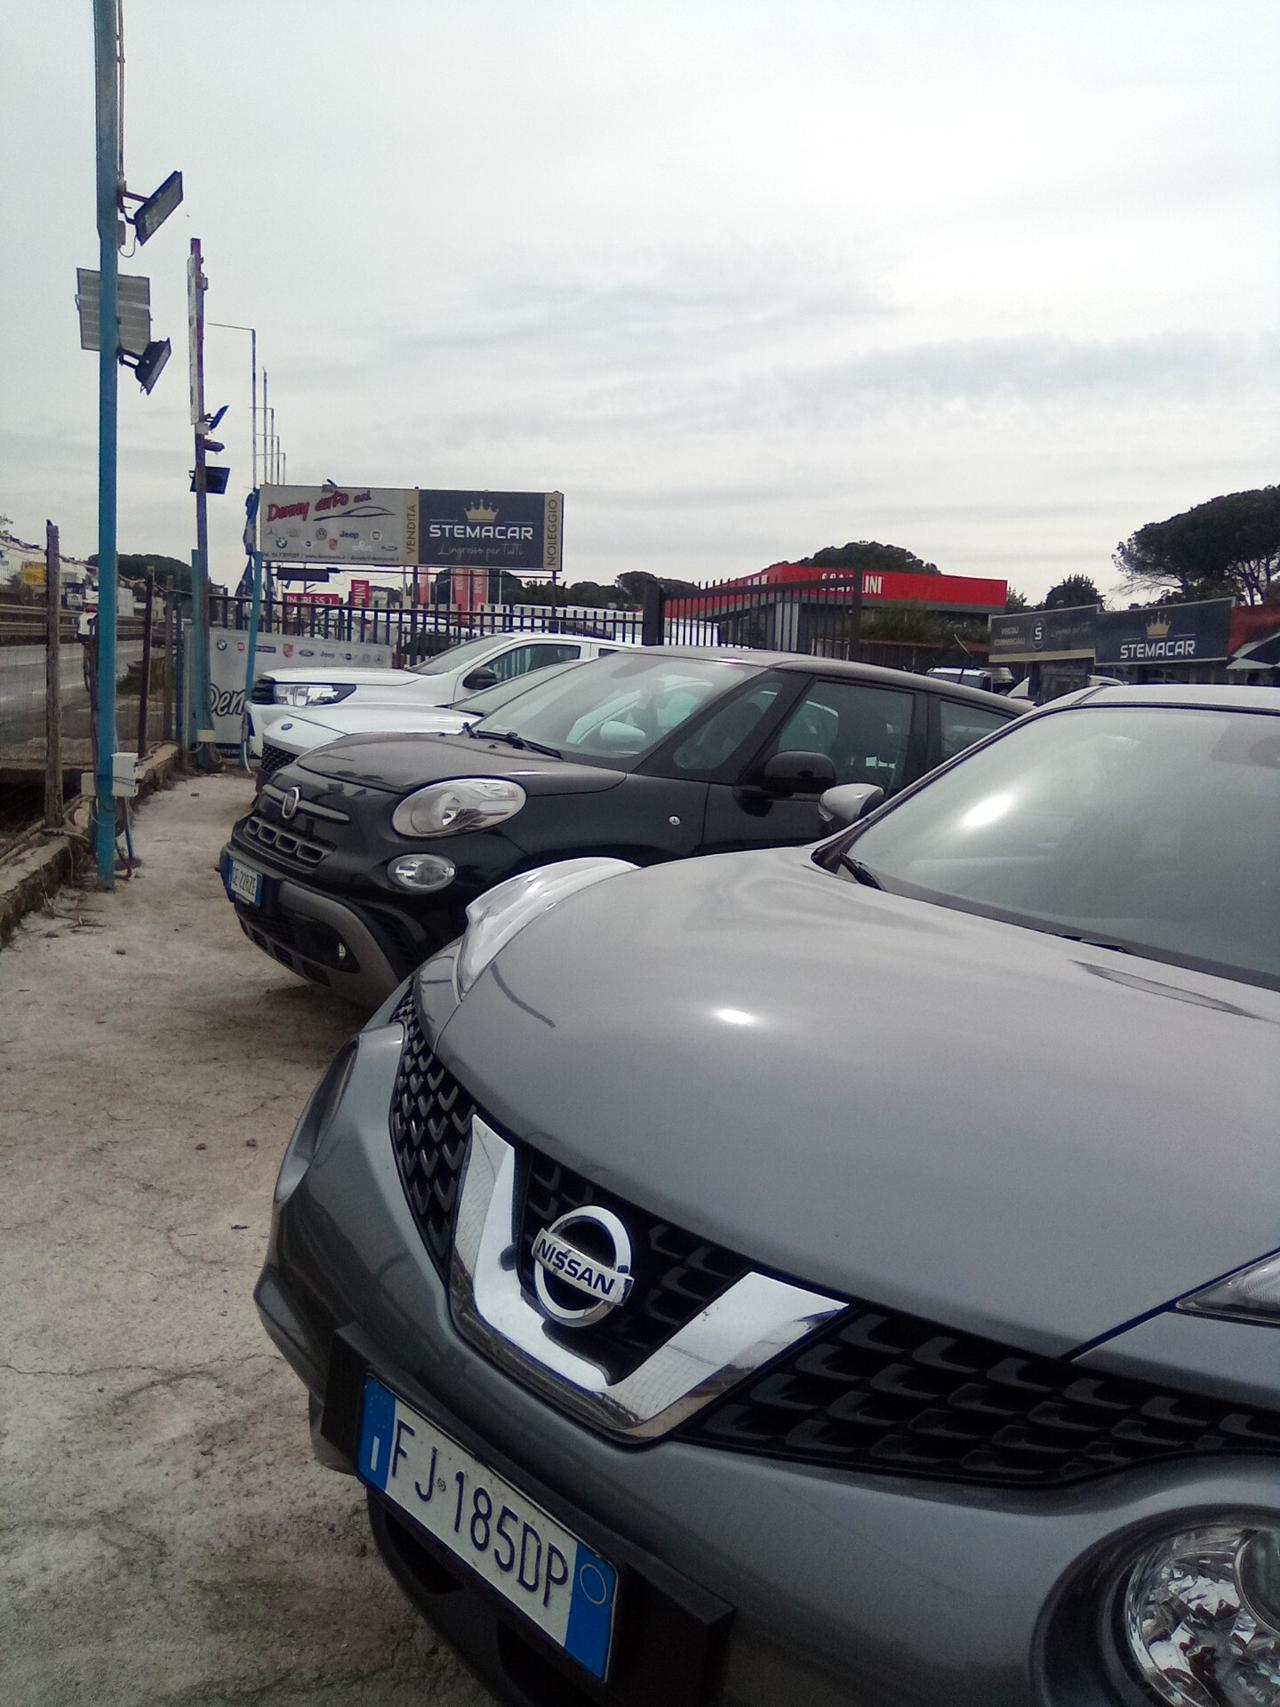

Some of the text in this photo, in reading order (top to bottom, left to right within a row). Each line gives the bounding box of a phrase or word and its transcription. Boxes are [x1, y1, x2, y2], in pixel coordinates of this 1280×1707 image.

[339, 530, 360, 540] Jeep
[405, 504, 417, 555] VENDITA
[429, 524, 533, 541] STEMACAR
[547, 498, 558, 566] NOLEGGIO
[485, 548, 499, 561] per
[1034, 627, 1042, 640] S
[1119, 639, 1196, 660] STEMACAR
[536, 1238, 616, 1296] NISSAN
[454, 1470, 569, 1610] 185DP
